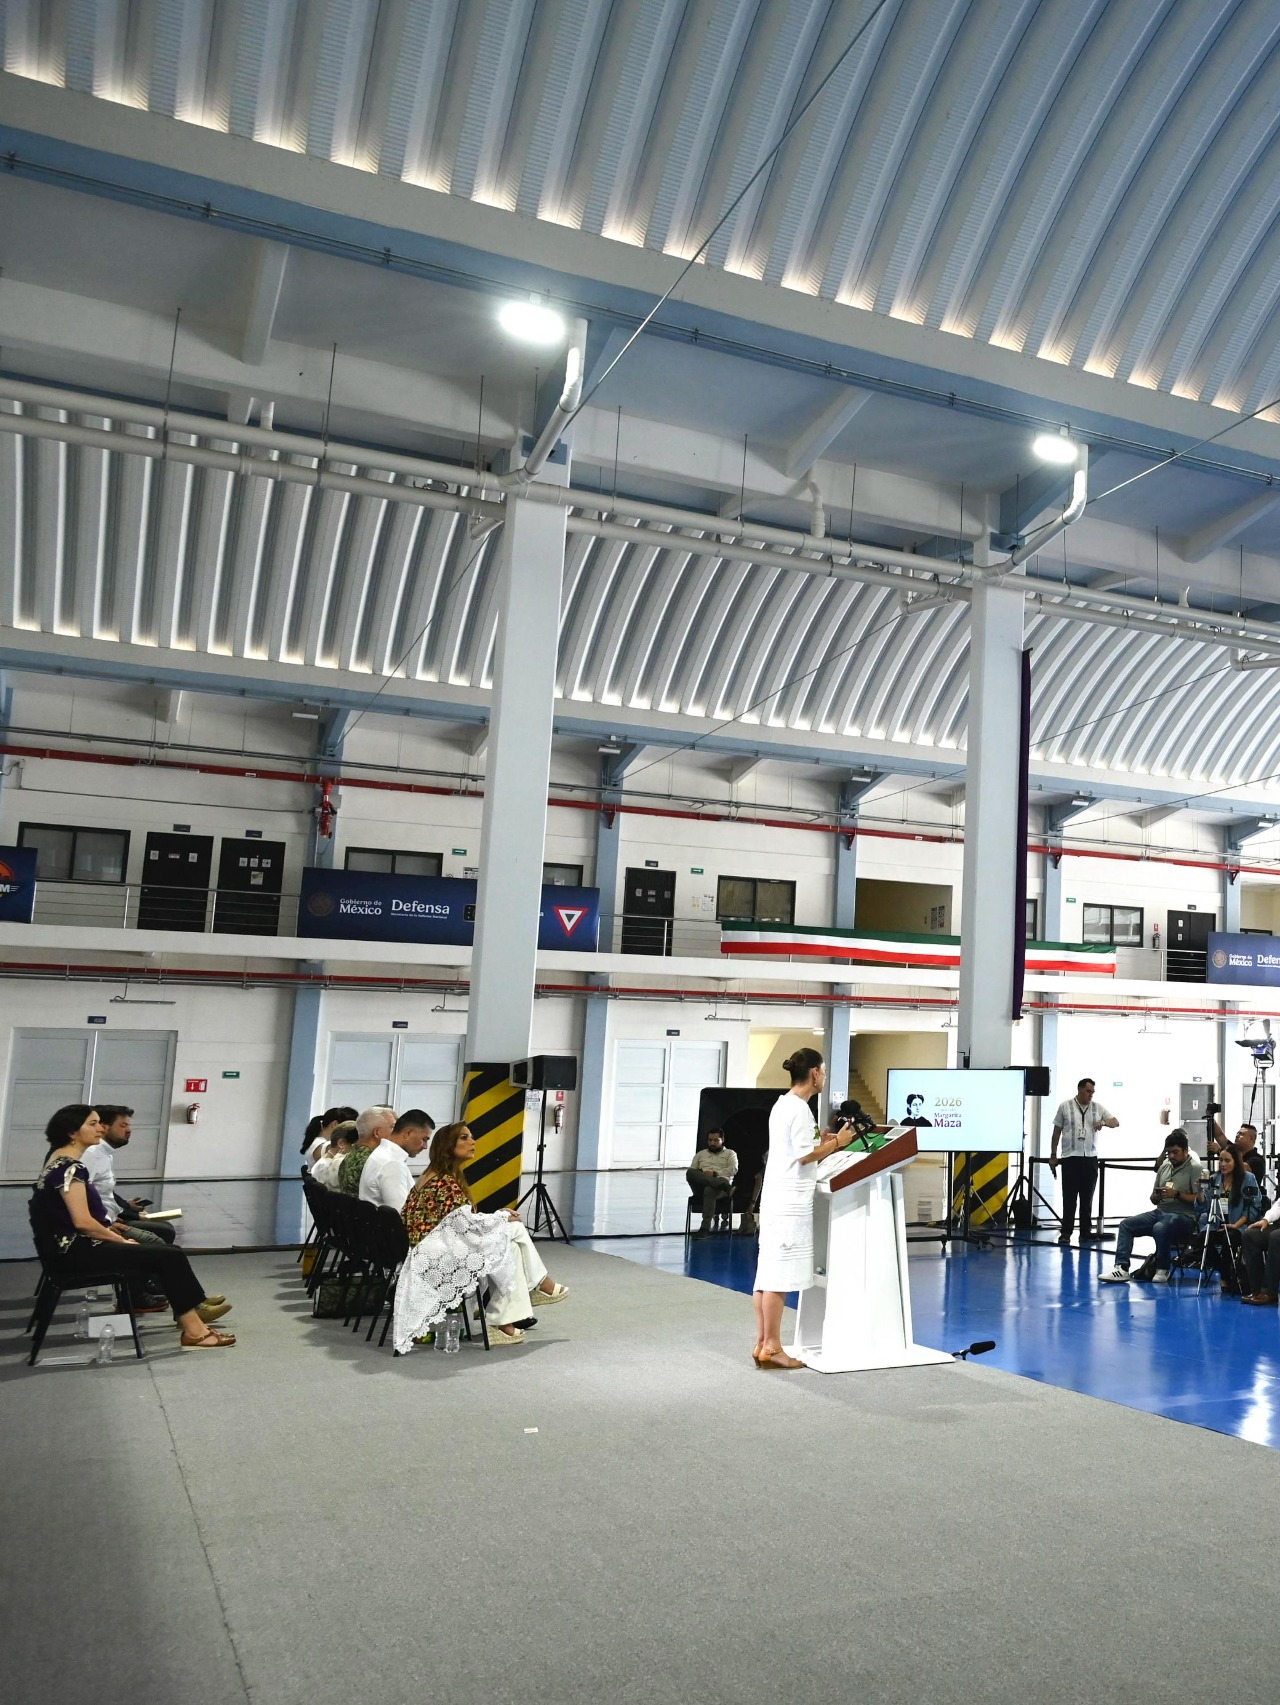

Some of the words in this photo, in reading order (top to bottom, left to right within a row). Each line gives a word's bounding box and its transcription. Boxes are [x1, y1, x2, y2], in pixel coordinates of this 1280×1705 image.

[340, 898, 372, 906] Gobierno
[391, 899, 450, 914] Defensa
[339, 904, 382, 915] México
[934, 1097, 962, 1107] 2026
[934, 1118, 962, 1128] Maza
